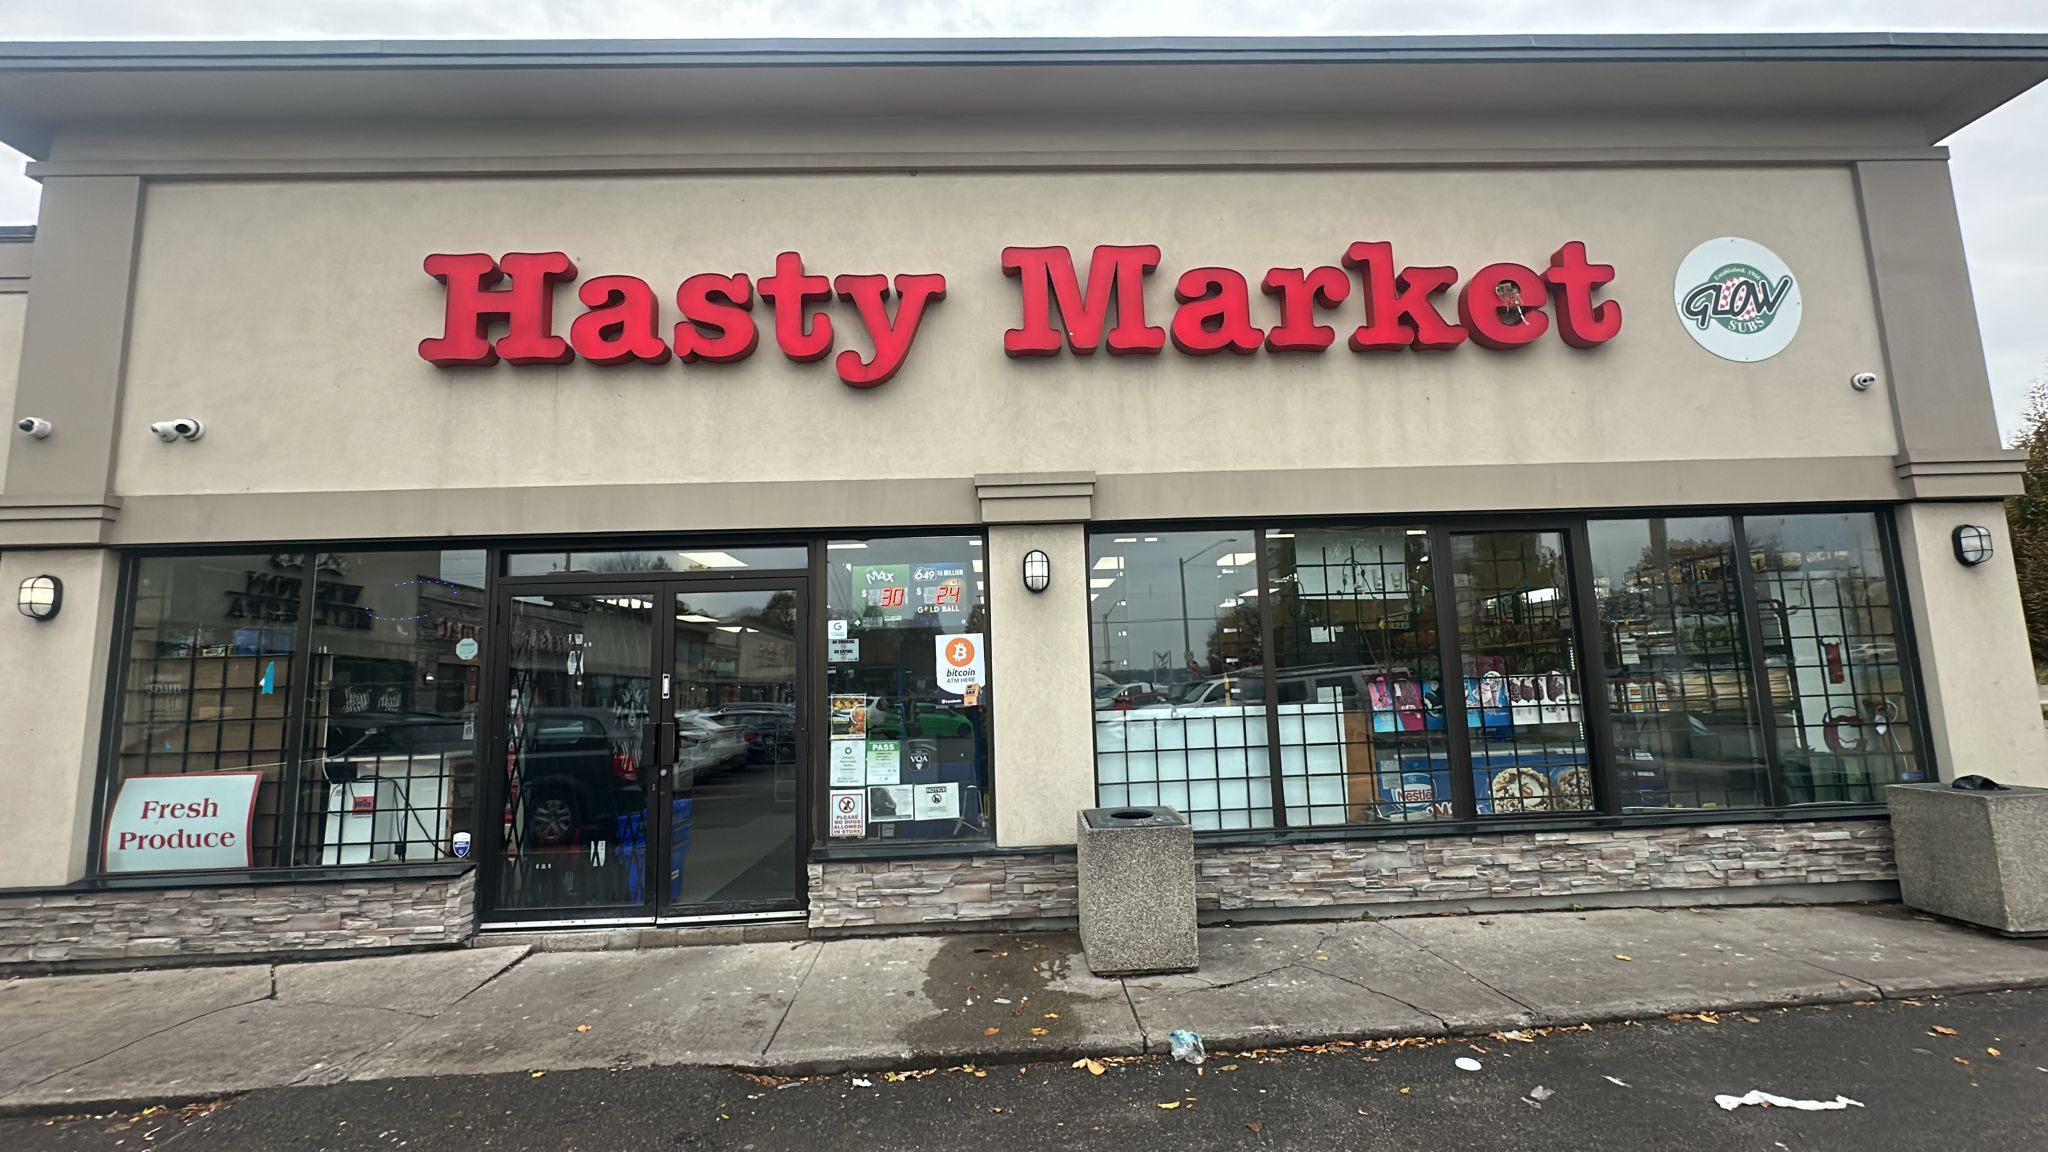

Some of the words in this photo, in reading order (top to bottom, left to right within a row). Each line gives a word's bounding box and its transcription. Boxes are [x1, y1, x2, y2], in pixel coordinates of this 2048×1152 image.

[1684, 277, 1791, 328] GLOW
[418, 251, 946, 388] Hasty
[1002, 241, 1622, 358] Market
[1727, 316, 1765, 333] SUBS
[866, 570, 895, 584] MAX
[914, 568, 935, 581] 649
[944, 568, 964, 577] MILLION
[881, 588, 905, 607] 30
[936, 585, 960, 605] 24
[942, 605, 960, 613] BALL
[833, 622, 842, 631] G
[946, 668, 976, 677] bitcoin
[910, 755, 929, 763] VQA
[140, 797, 219, 820] Fresh
[119, 828, 236, 851] Produce
